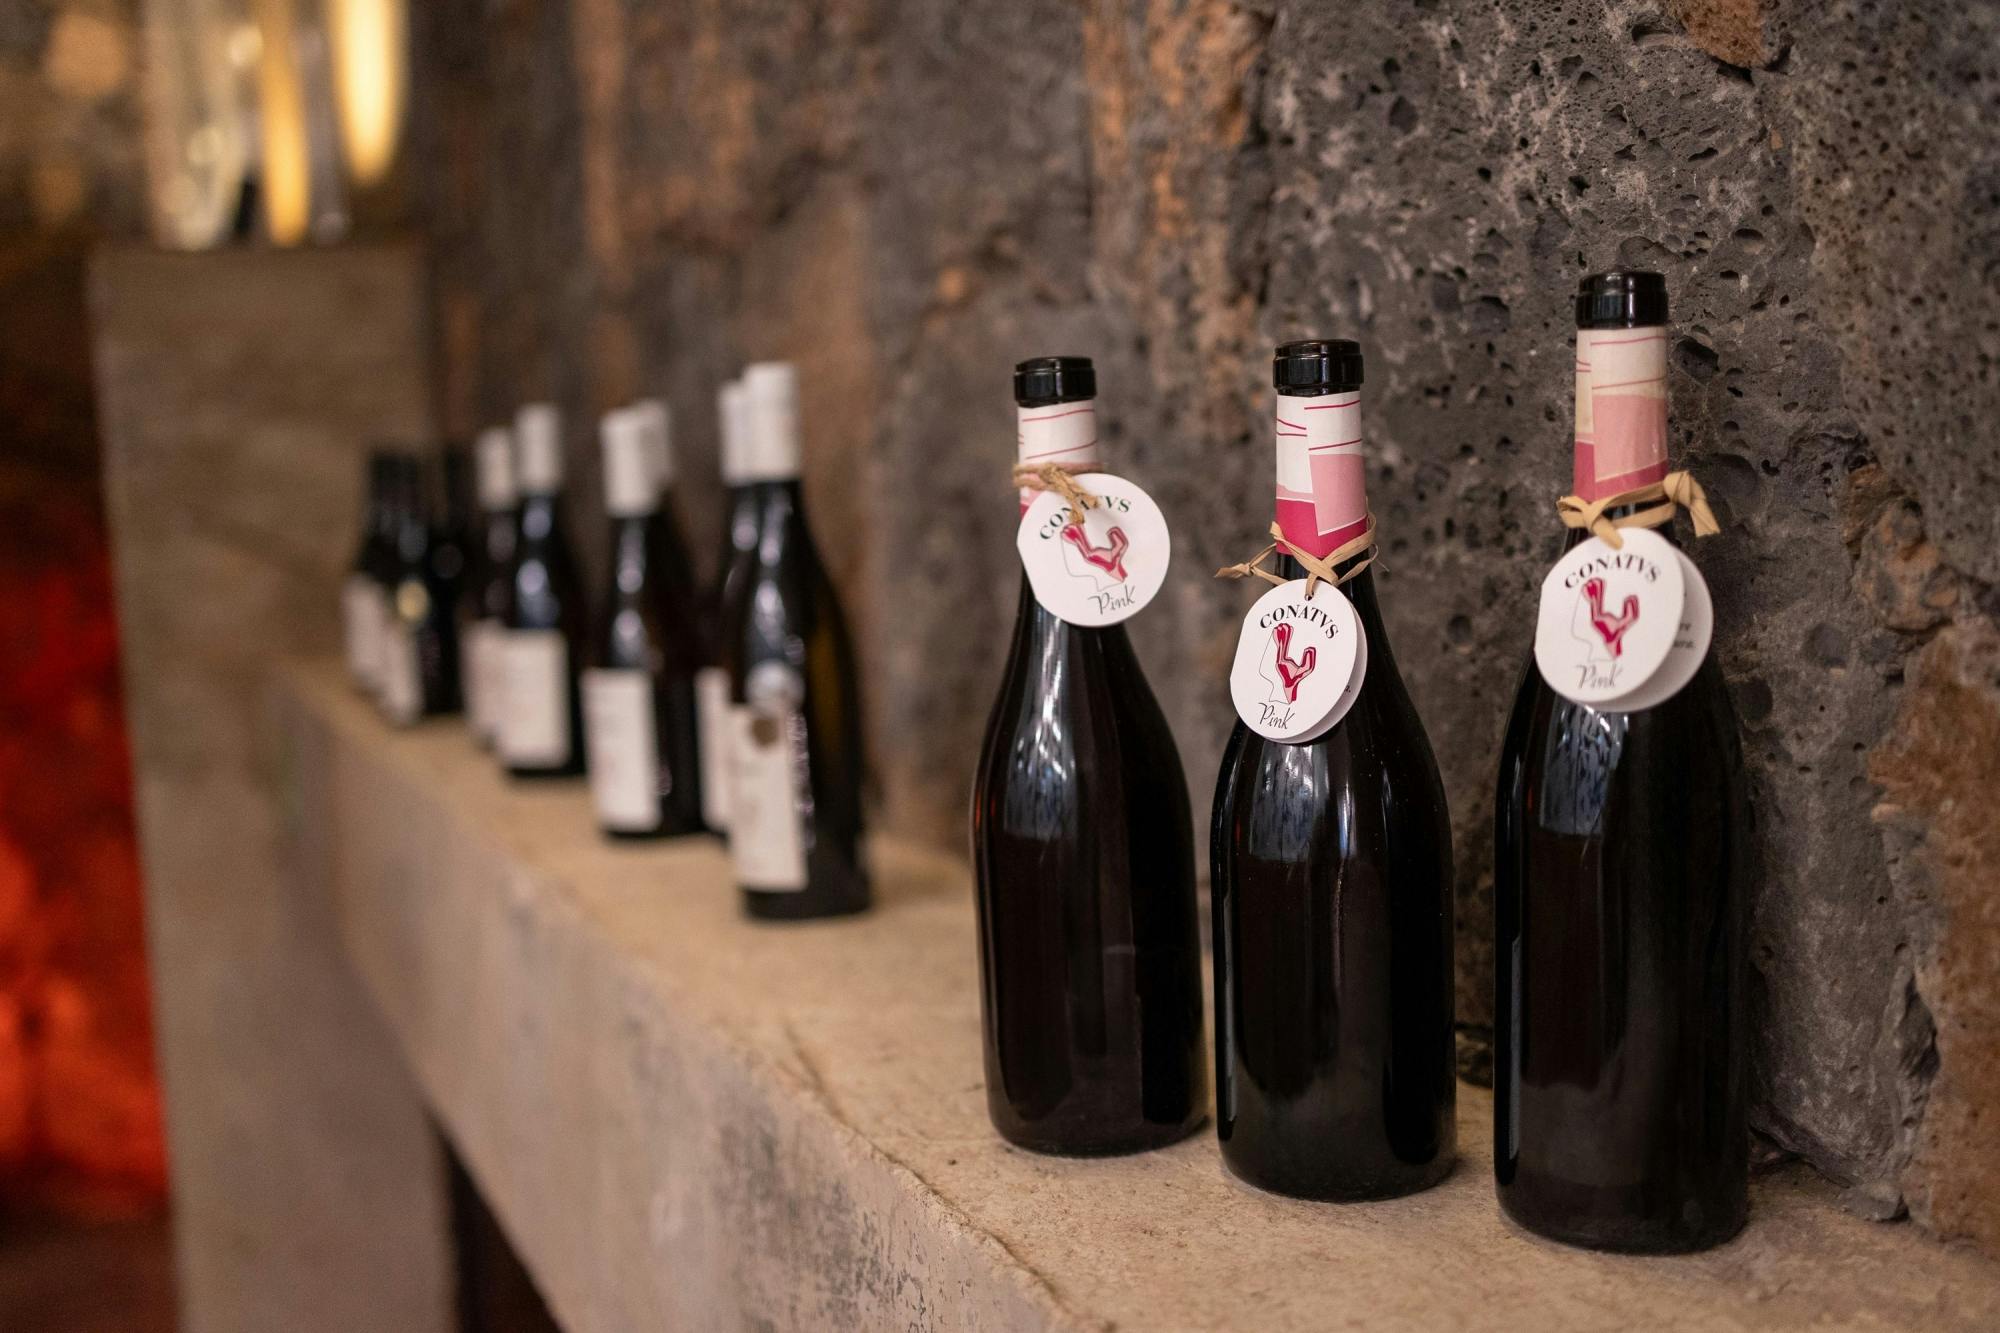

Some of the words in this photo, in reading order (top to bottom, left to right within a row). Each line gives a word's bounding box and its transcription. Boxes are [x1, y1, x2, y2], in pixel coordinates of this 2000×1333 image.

[1040, 496, 1131, 540] COVS
[1565, 554, 1660, 589] CONATVS
[1088, 585, 1135, 615] Pink
[1260, 604, 1339, 639] CONATVS
[1576, 664, 1623, 689] Pink
[1258, 702, 1295, 730] Pink
